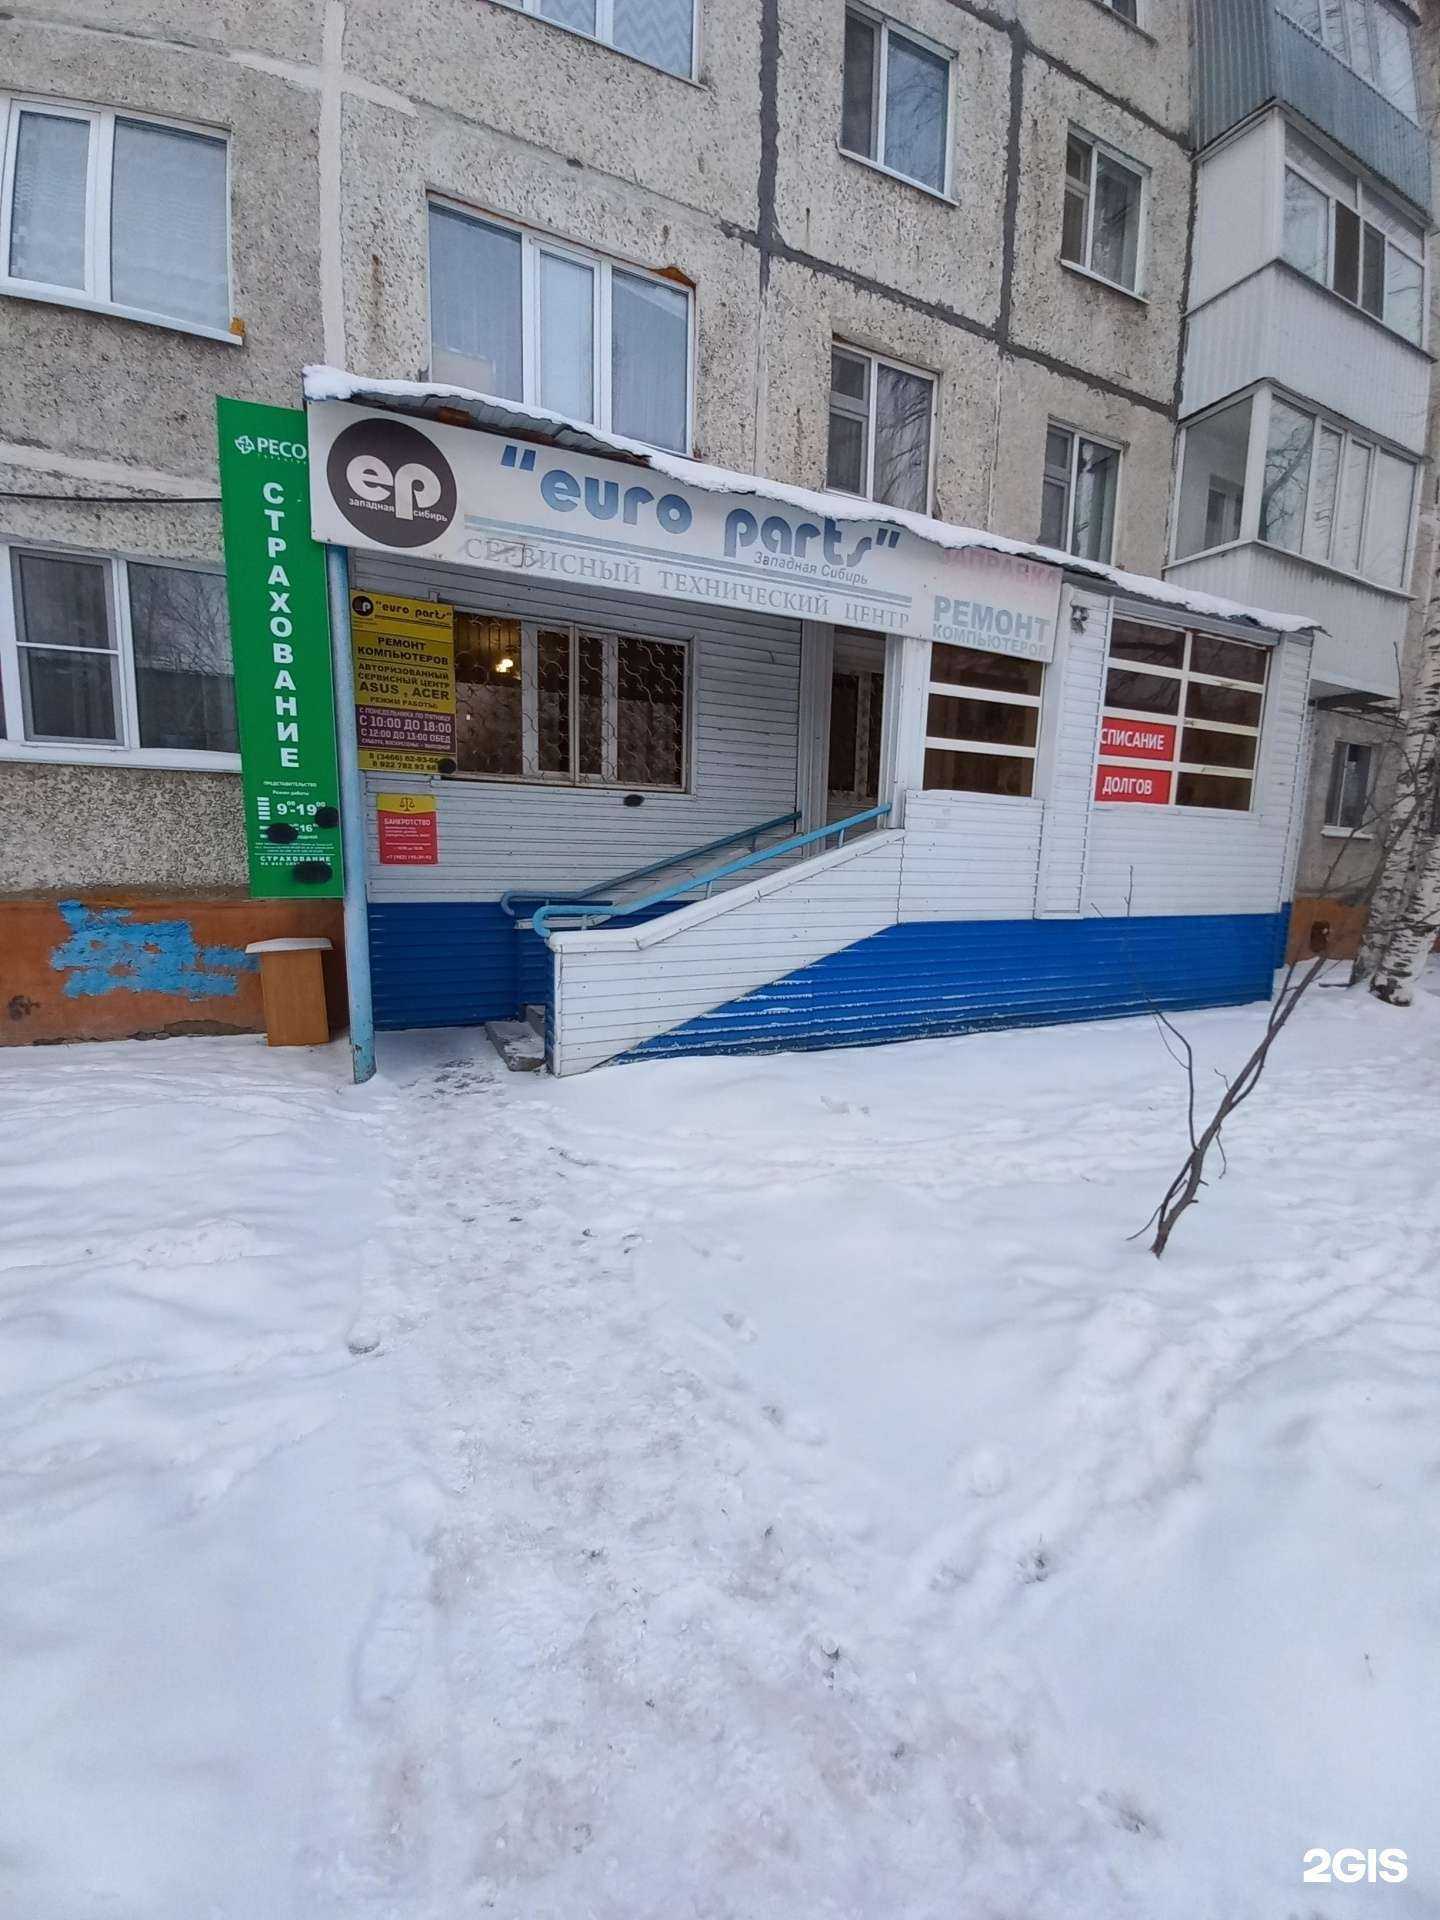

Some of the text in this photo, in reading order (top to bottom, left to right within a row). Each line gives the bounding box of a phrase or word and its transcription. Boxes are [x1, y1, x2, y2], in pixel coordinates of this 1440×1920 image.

[257, 436, 307, 460] РЕСО
[346, 455, 442, 521] ep
[348, 498, 395, 513] западная
[413, 509, 448, 522] сибирь
[754, 550, 869, 585] Западная Сибирь
[464, 536, 909, 630] СЕРВИСНЫЙ ТЕХНИЧЕСКИЙ ЦЕНТР
[262, 482, 301, 768] СТРАХОВАНИЕ
[934, 594, 1050, 643] РЕМОНТ
[378, 637, 426, 651] РЕМОНТ
[358, 646, 448, 665] КОМПЬЮТЕРОВ
[358, 662, 449, 680] АВТОРИЗОВАННЫЙ
[358, 672, 450, 689] СЕРВИСНЫЙ ЦЕНТР
[359, 681, 399, 695] ASUS
[412, 687, 450, 701] ACER
[360, 715, 452, 733] С 10:00 ДО 18:00
[361, 728, 367, 736] С
[369, 728, 391, 738] 12:00
[393, 731, 405, 740] ДО
[430, 734, 451, 744] ОБЕД
[1100, 727, 1165, 751] СПИСАНИЕ
[1102, 775, 1153, 796] ДОЛГОВ
